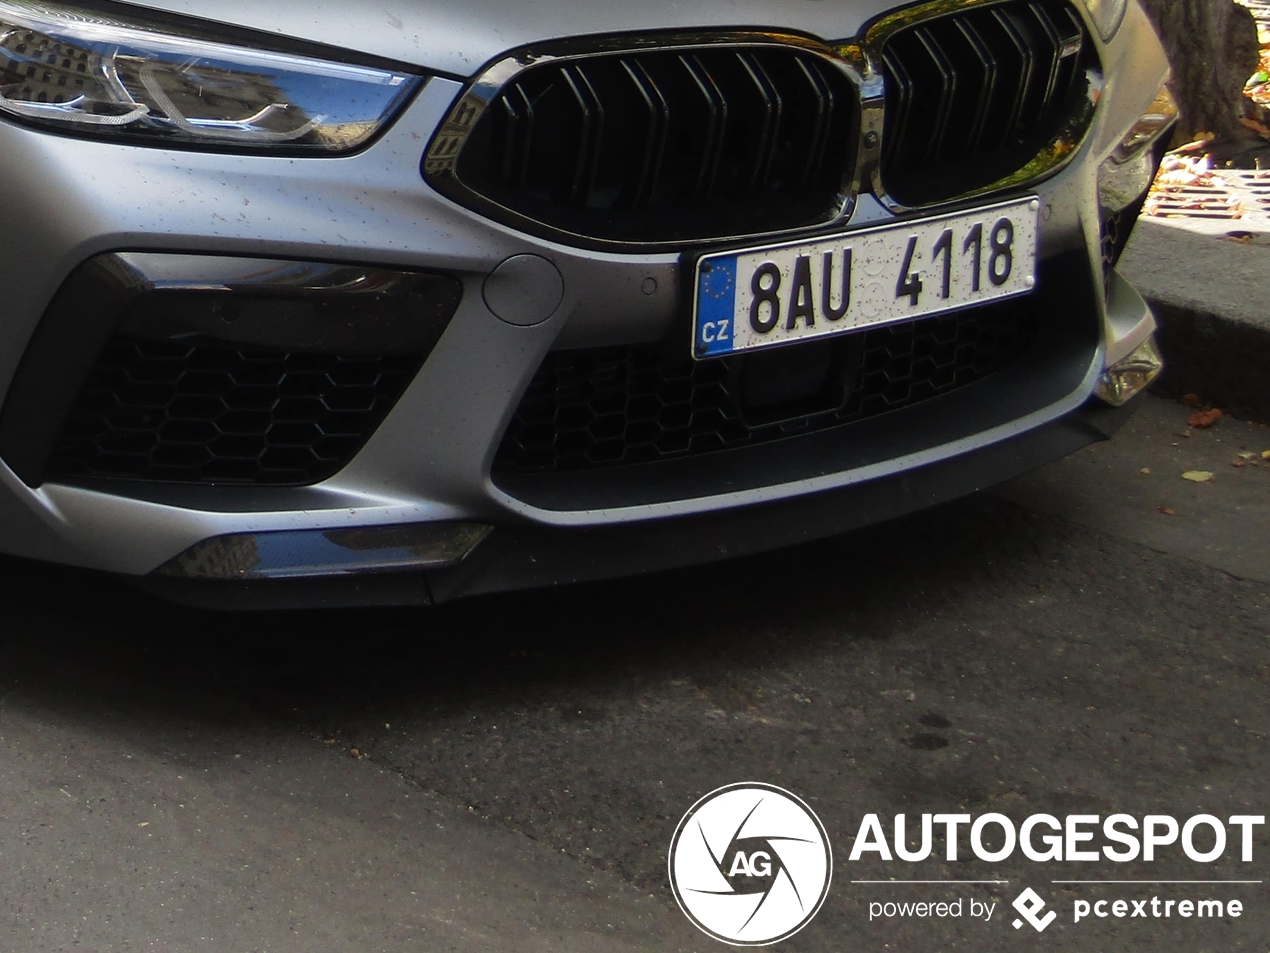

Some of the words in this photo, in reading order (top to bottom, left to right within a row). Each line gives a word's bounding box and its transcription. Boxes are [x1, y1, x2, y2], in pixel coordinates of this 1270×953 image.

[749, 247, 852, 334] 8AU
[895, 215, 1014, 306] 4118
[701, 319, 729, 343] CZ
